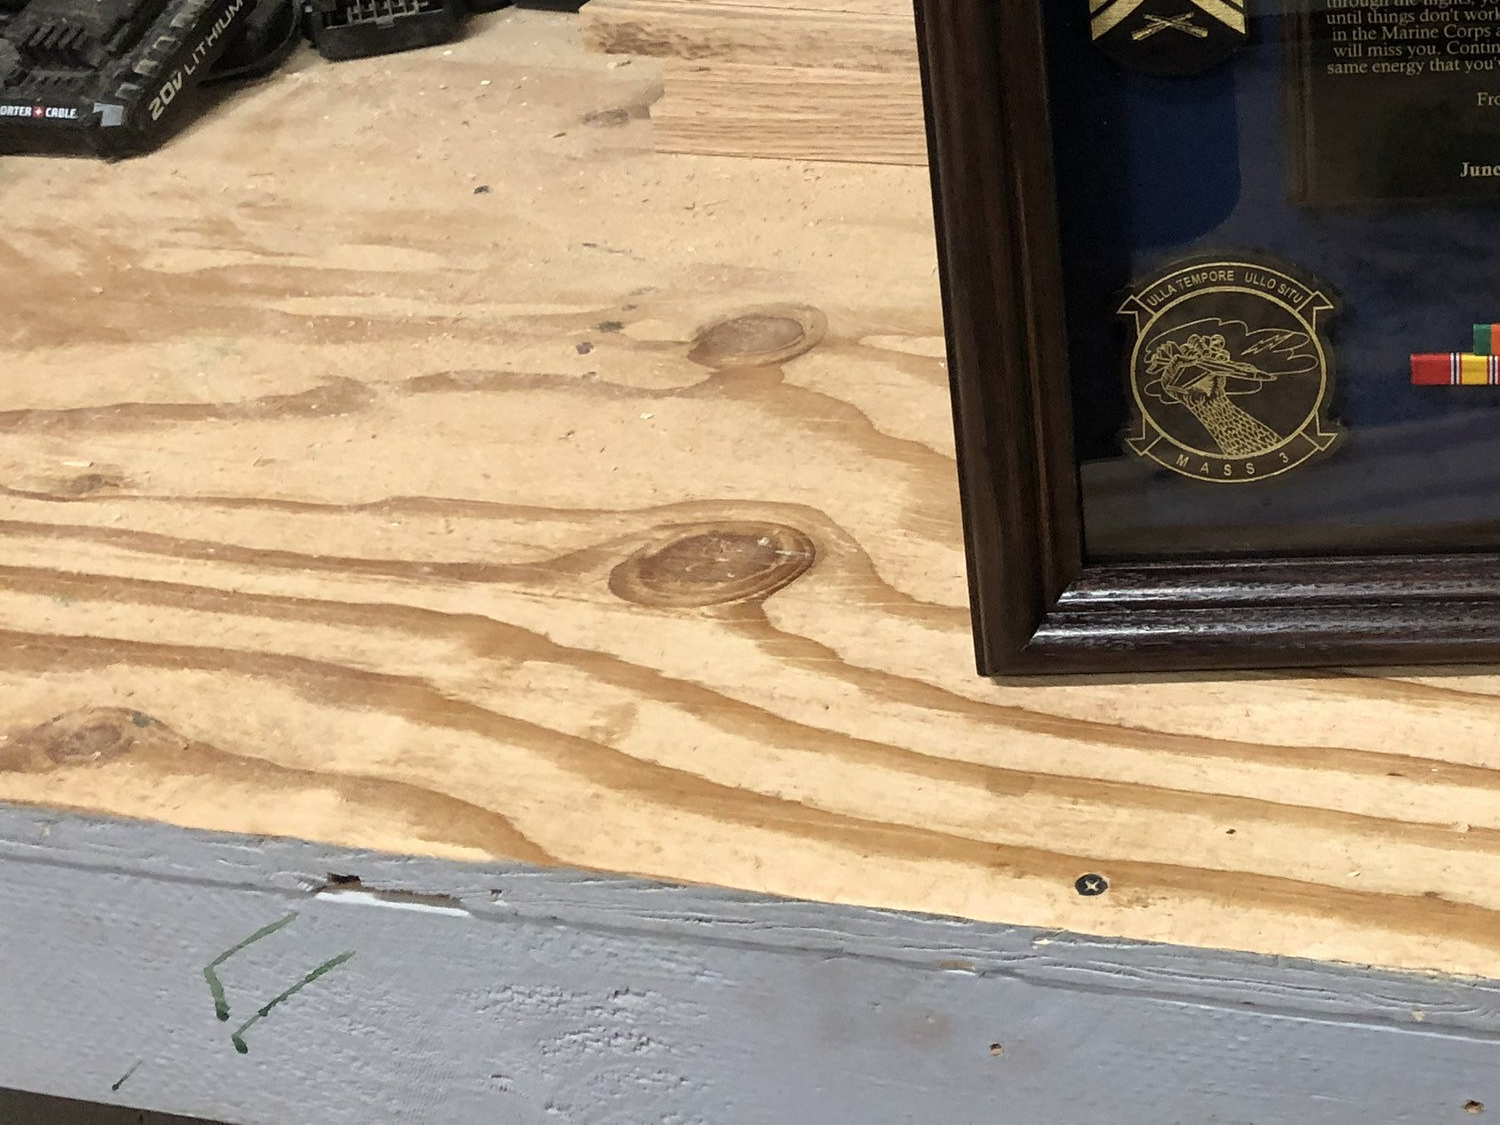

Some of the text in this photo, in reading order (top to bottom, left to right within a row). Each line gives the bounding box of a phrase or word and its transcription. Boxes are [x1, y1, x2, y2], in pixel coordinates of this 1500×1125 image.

[1332, 43, 1362, 57] will
[1367, 42, 1403, 56] miss
[1406, 44, 1441, 59] you.
[148, 72, 182, 121] 20V
[0, 106, 77, 118] ORTER CABLE
[1147, 270, 1304, 307] ULLA TEMPORE ULLO SITU
[1175, 453, 1289, 476] MASS 3
